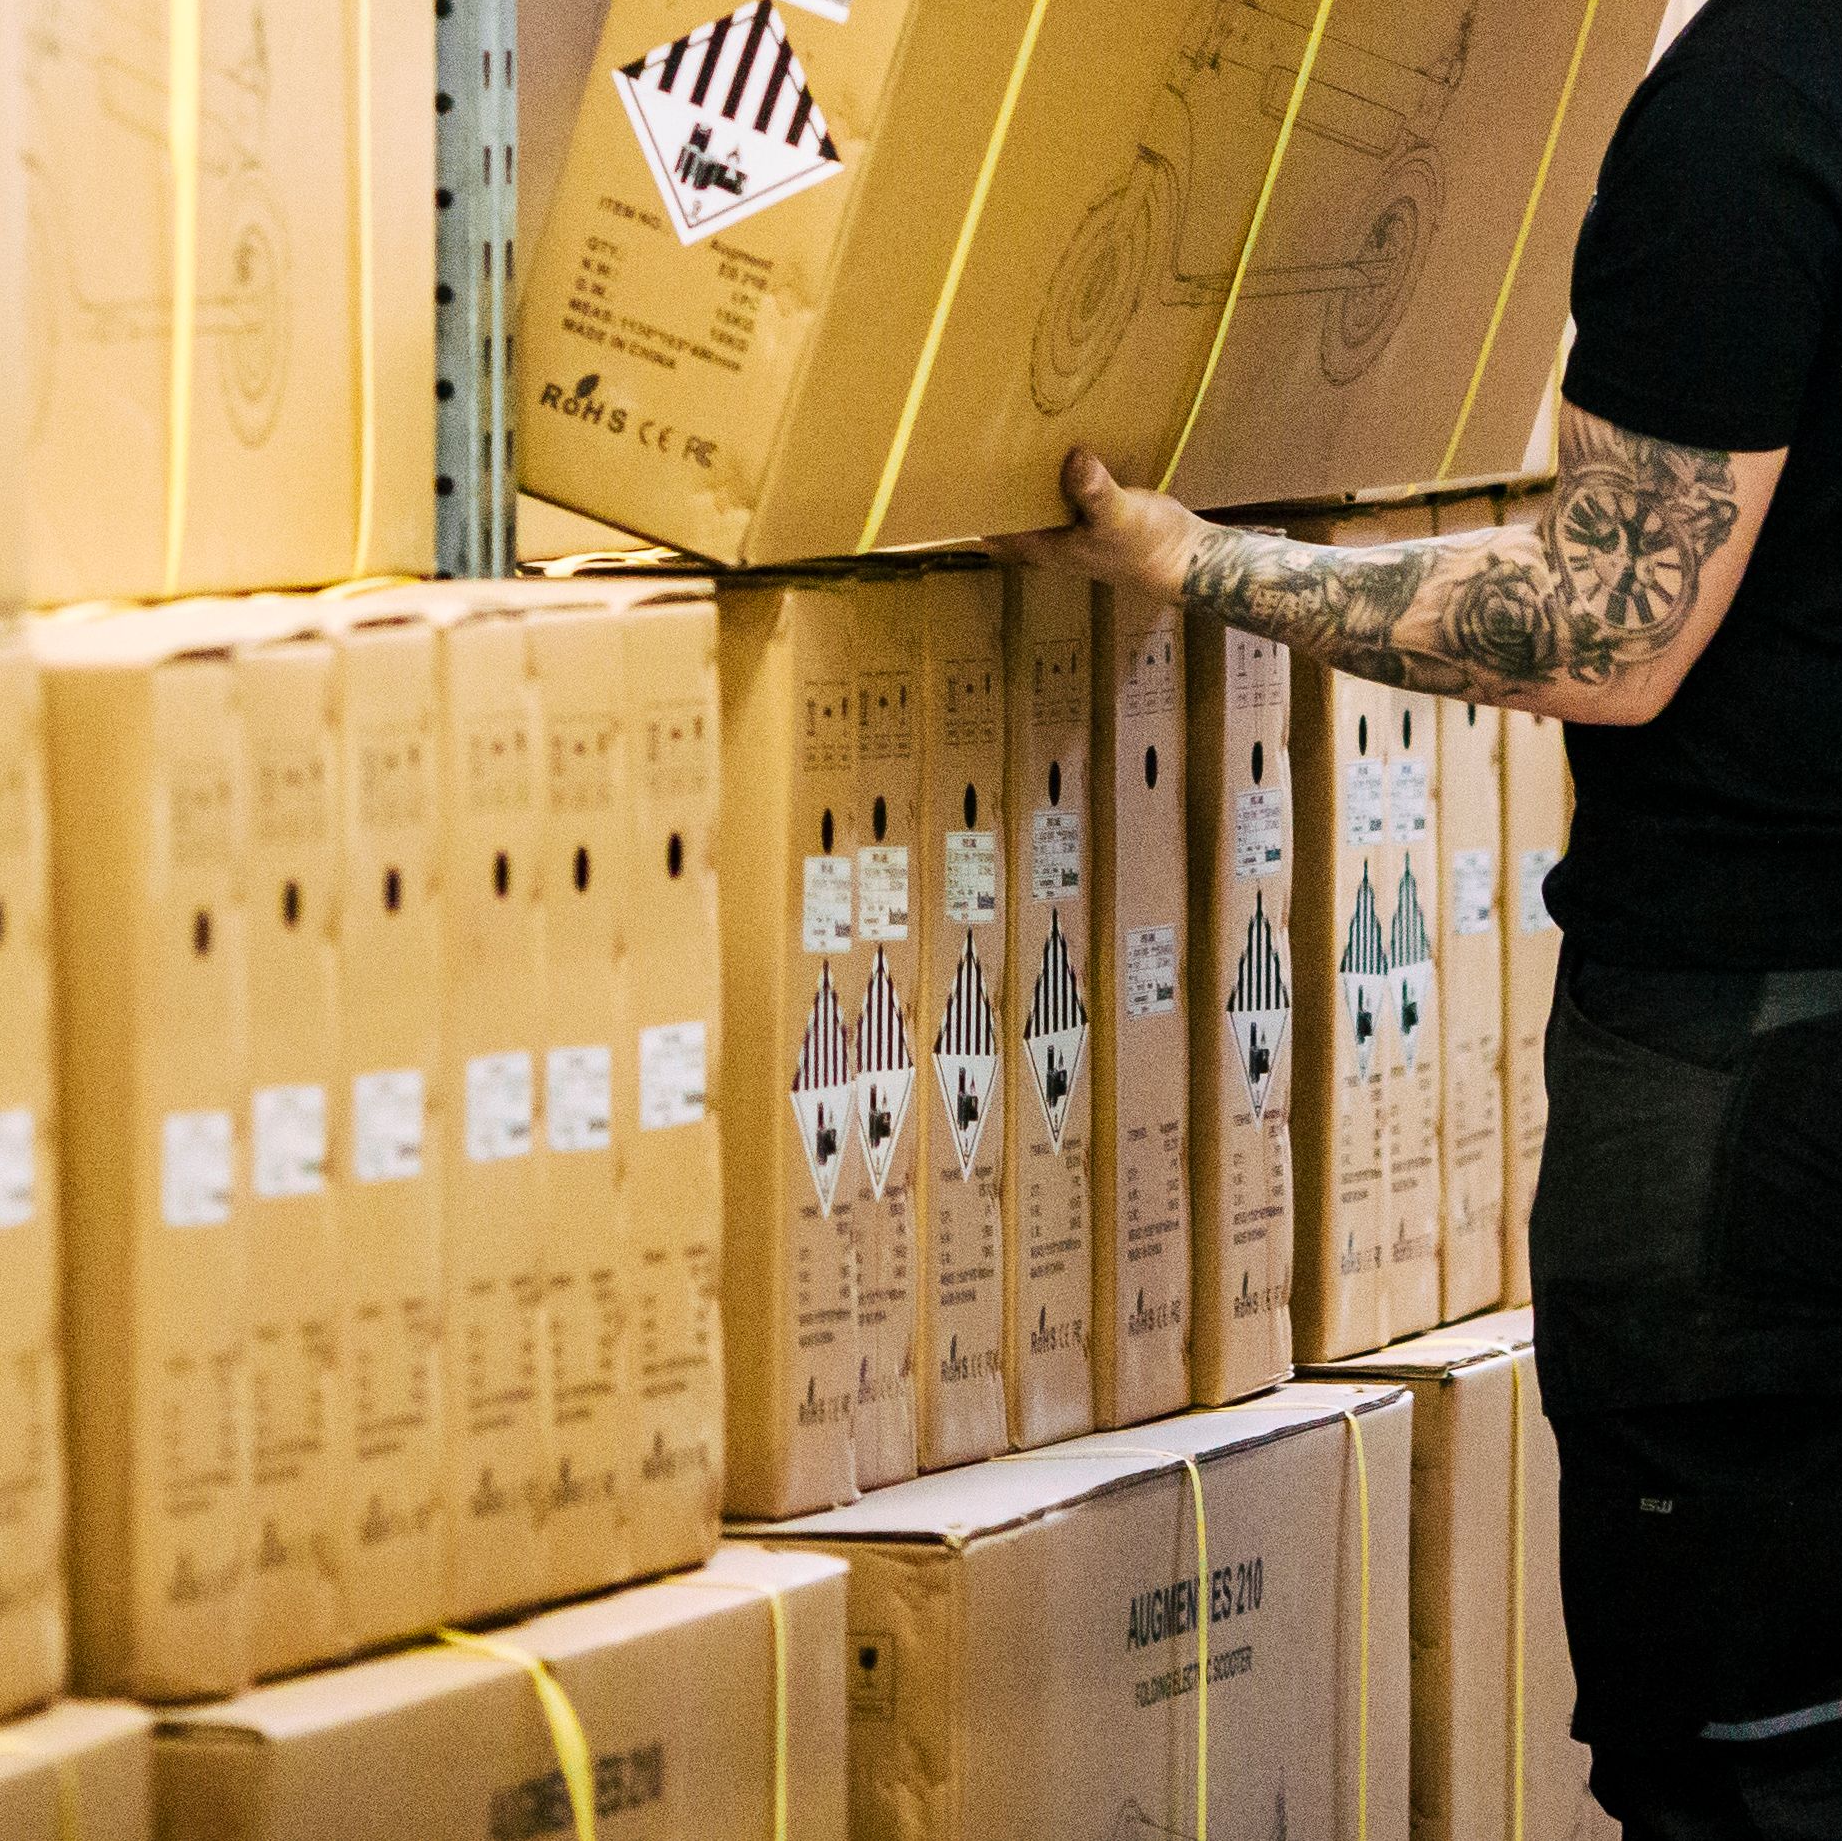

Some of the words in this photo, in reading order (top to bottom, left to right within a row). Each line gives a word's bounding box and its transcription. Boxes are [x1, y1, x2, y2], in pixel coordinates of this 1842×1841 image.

[561, 316, 607, 344] MADE
[609, 333, 627, 352] IN
[627, 341, 678, 370] CHINA
[1211, 1566, 1233, 1623] ES
[1236, 1556, 1264, 1615] 210
